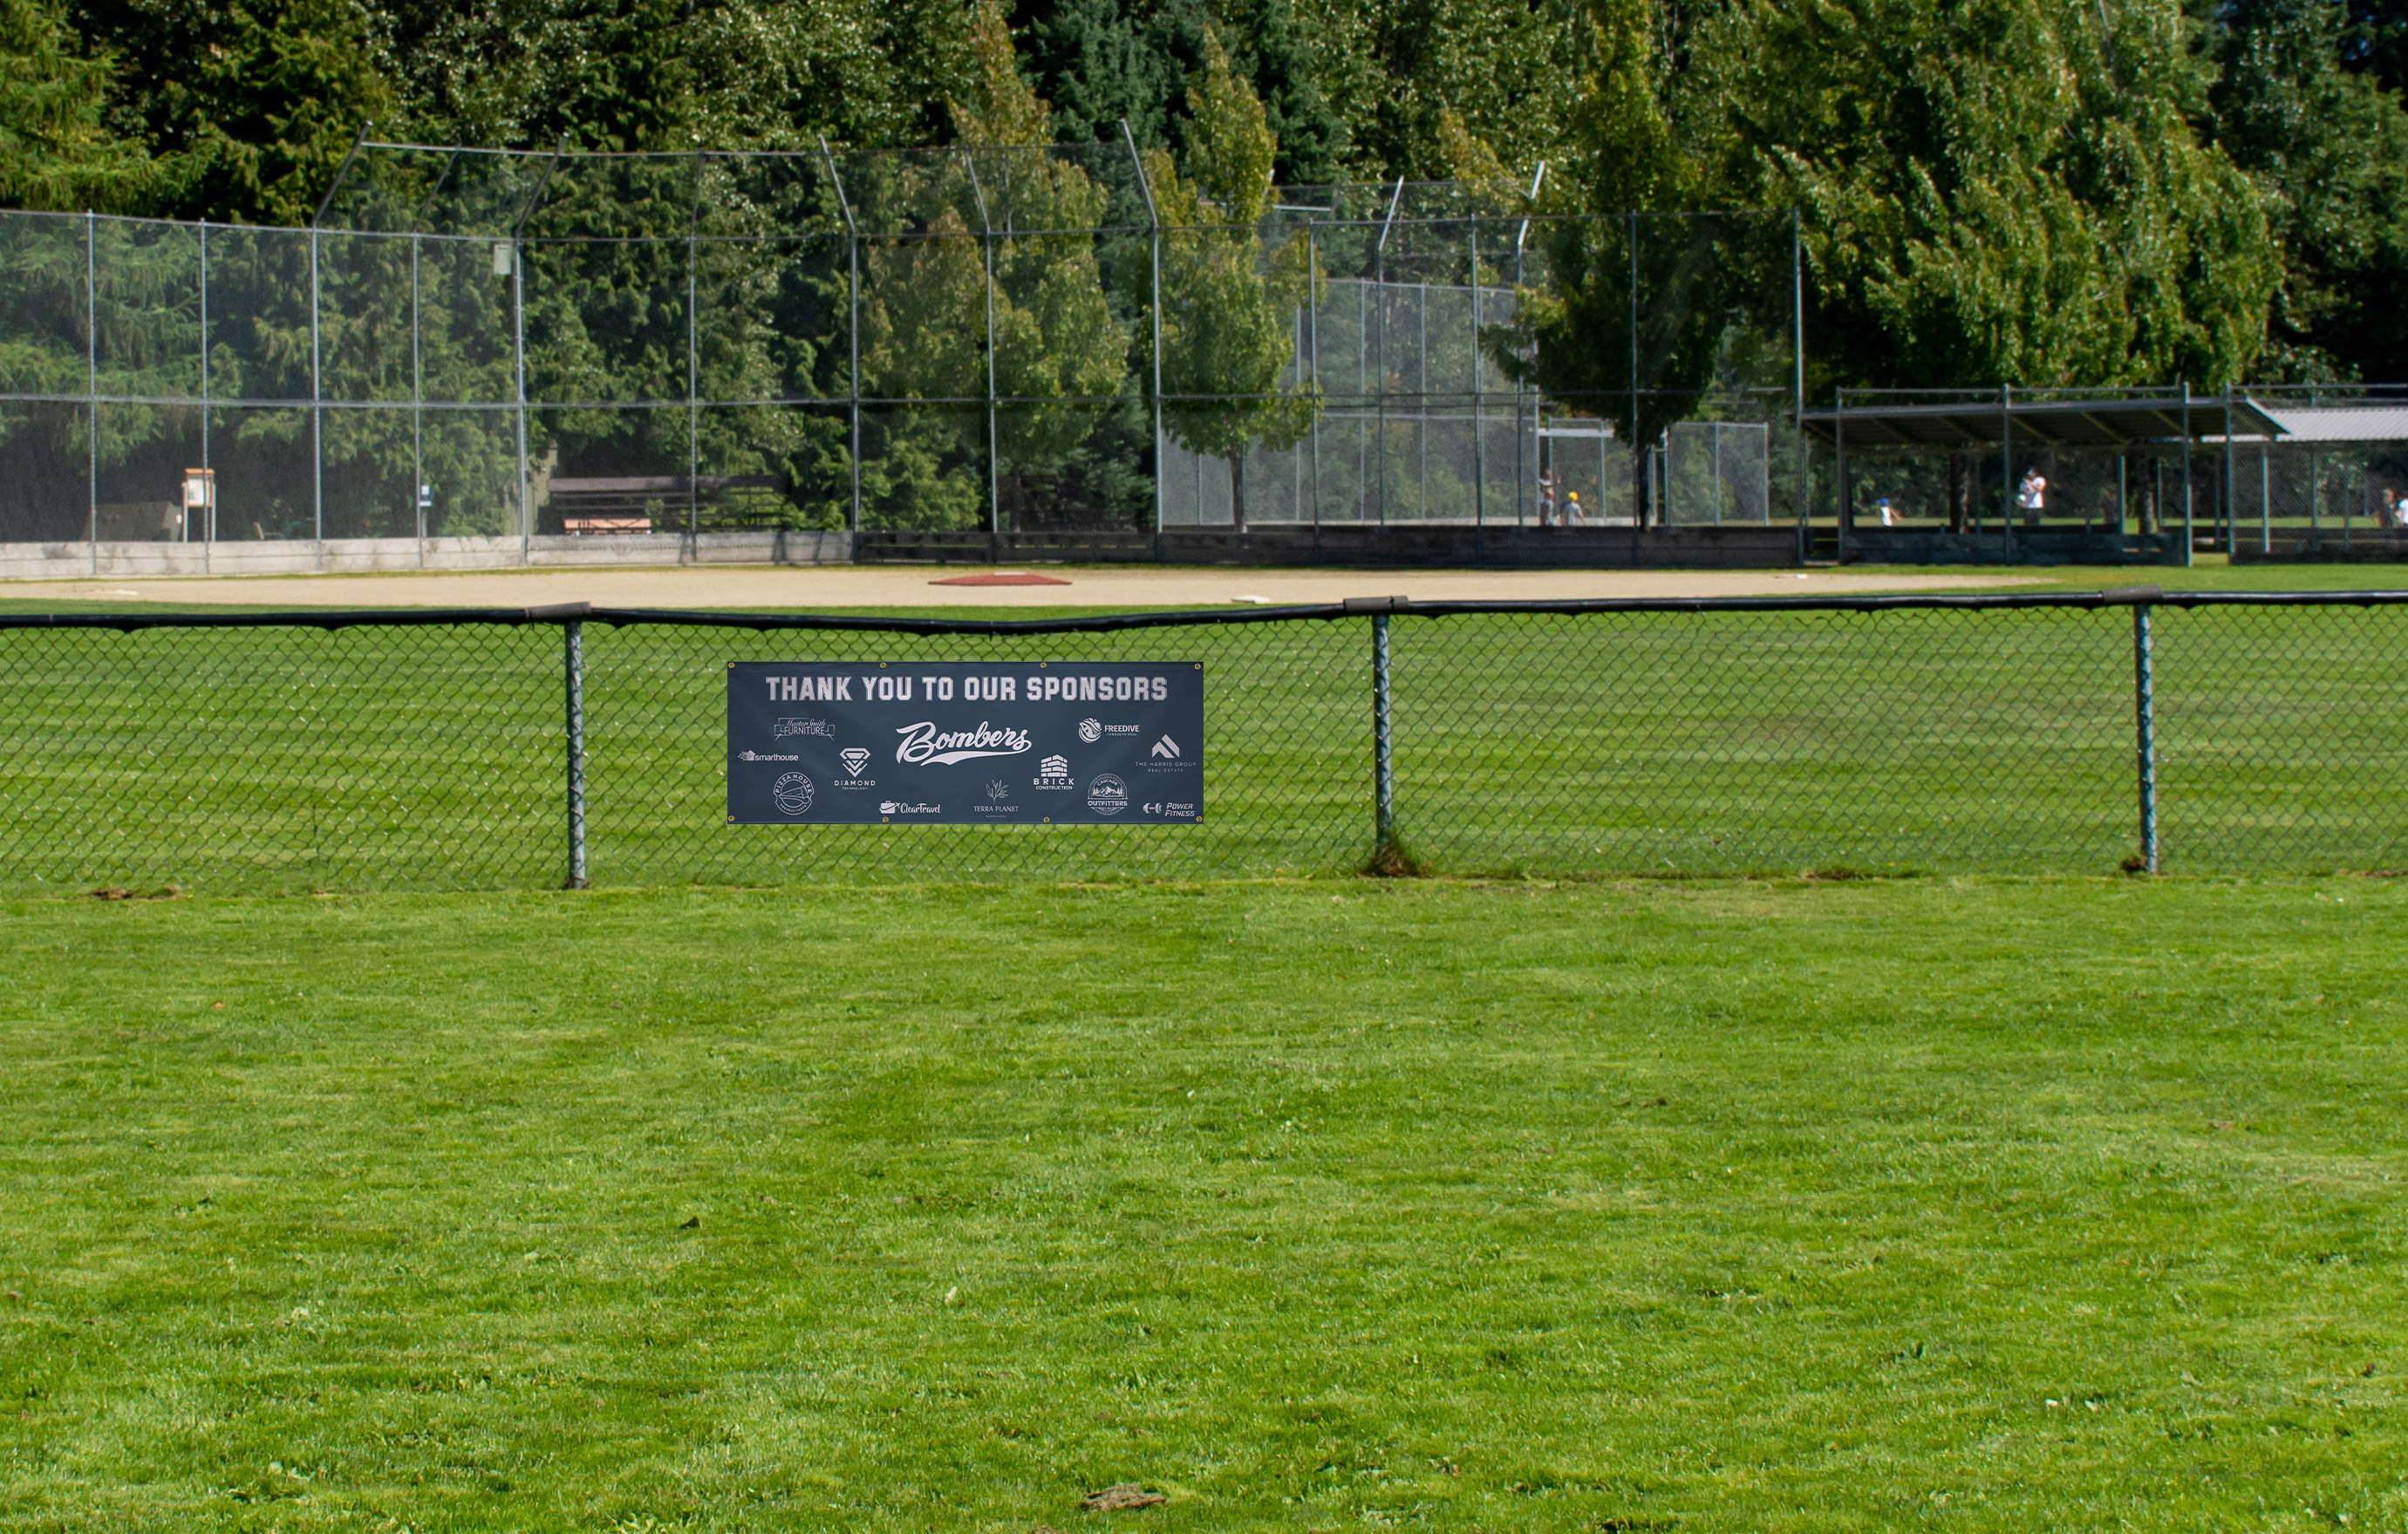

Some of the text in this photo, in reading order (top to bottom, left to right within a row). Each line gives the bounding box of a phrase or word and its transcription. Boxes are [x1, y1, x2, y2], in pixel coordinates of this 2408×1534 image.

[765, 676, 1168, 701] THANK YOU TO OUR SPONSORS
[784, 726, 825, 735] FURNITURE
[809, 718, 826, 727] Smith
[896, 720, 1032, 764] Bombers
[774, 774, 813, 794] PIZZA HOUSE
[900, 802, 940, 814] ClearTravel
